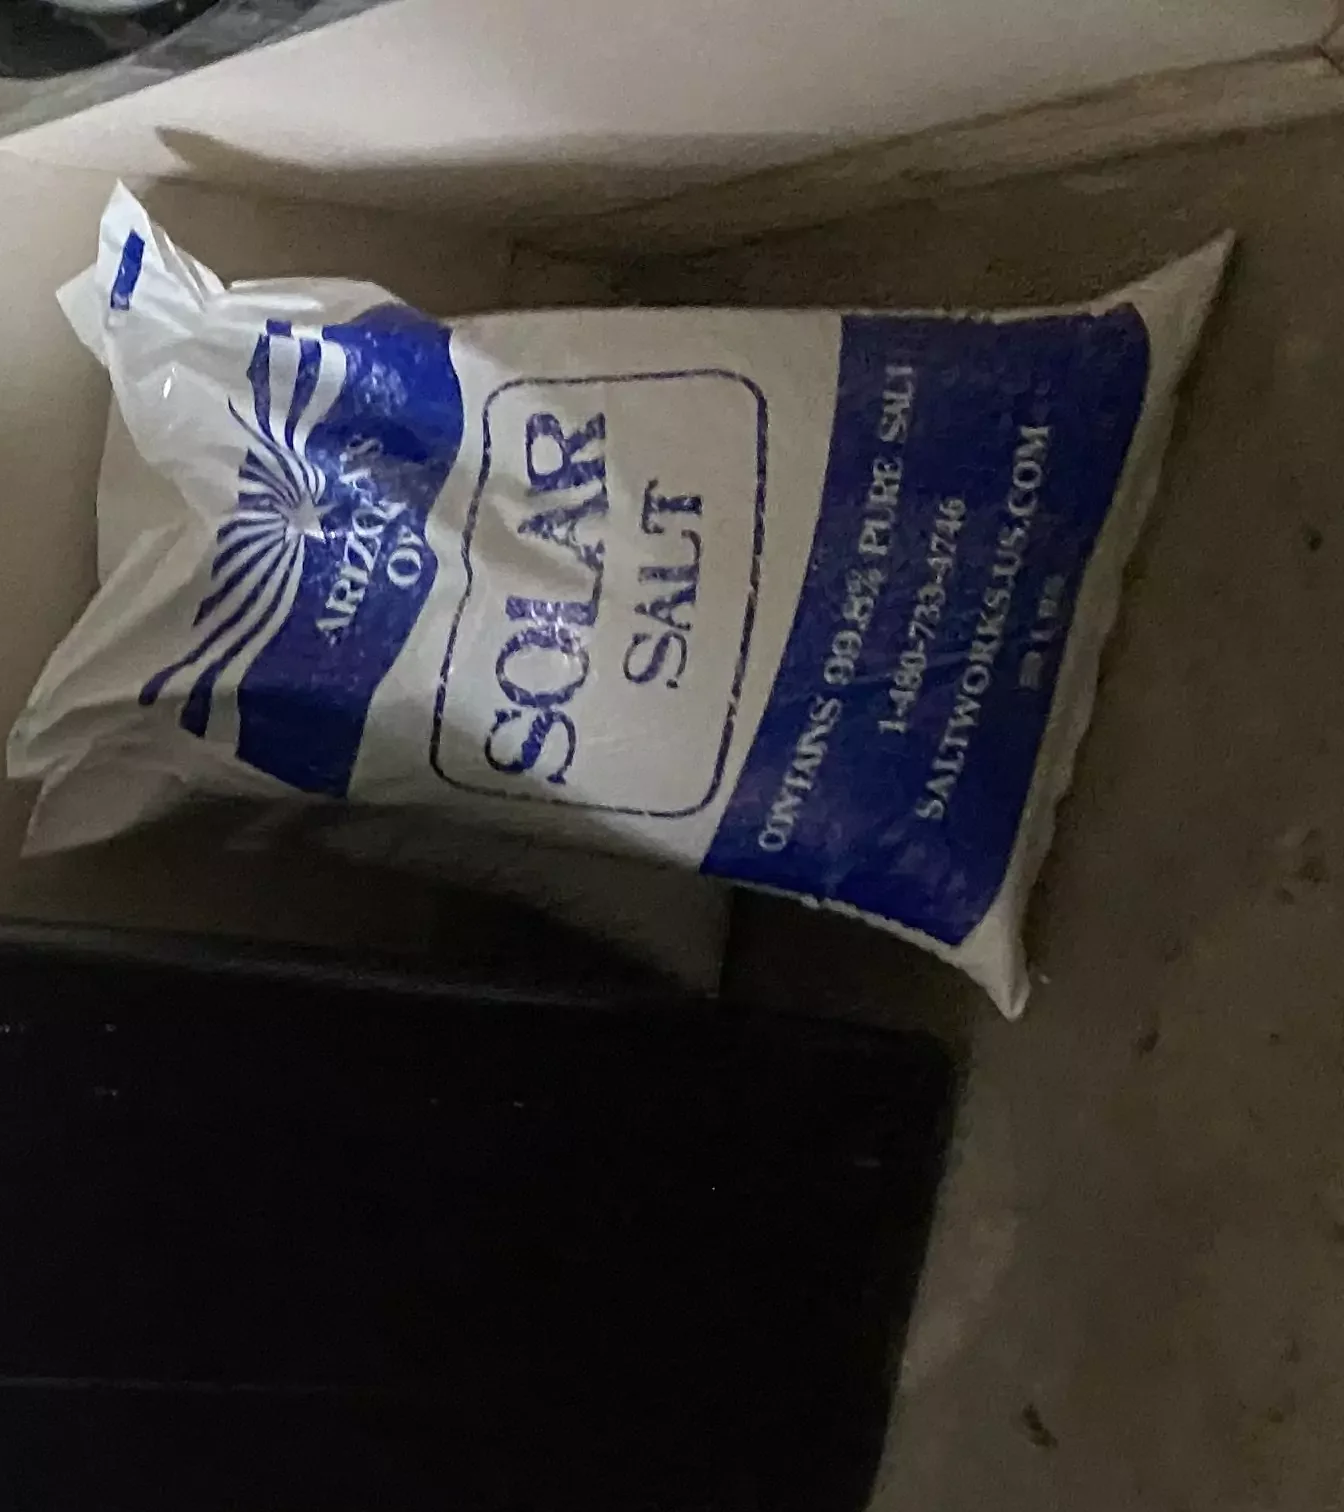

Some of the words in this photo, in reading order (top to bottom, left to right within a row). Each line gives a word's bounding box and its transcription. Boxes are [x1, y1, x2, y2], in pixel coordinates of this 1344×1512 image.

[484, 412, 609, 785] SOLAR
[622, 478, 703, 689] SALT
[758, 696, 843, 852] CONTAINS
[823, 567, 889, 686] 99.8%
[859, 455, 904, 556] PURE
[879, 496, 967, 736] 1-480-733-4746
[916, 424, 1052, 821] SALTWORKS.US.COM
